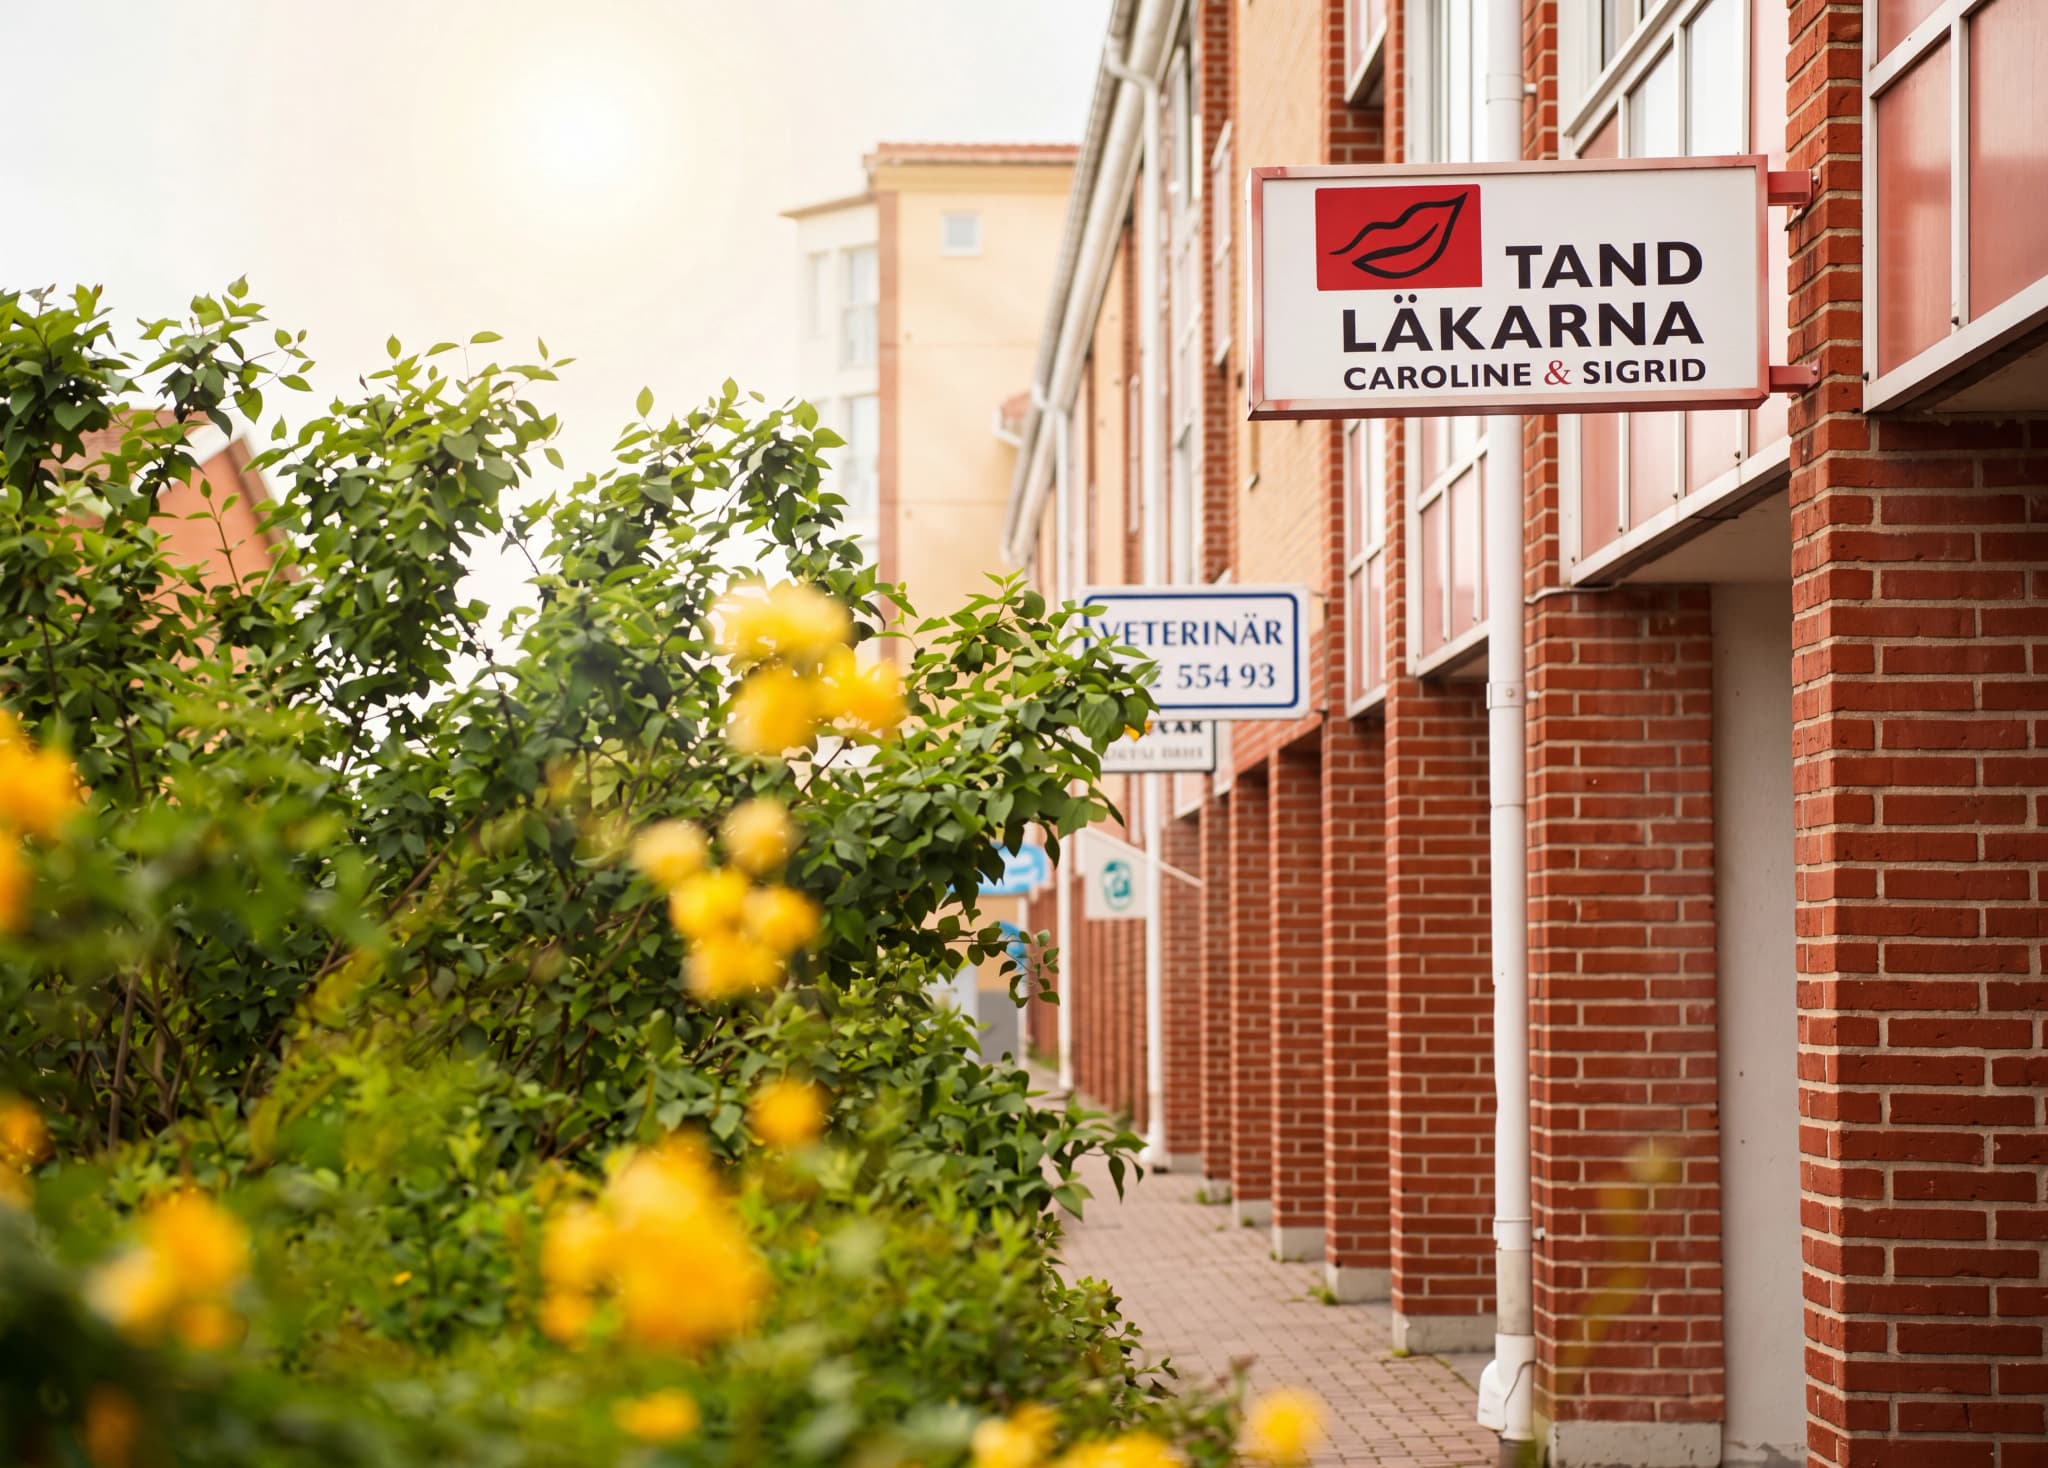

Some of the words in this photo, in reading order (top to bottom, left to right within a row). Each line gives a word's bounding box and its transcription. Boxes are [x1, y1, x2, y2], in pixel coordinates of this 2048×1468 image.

[1505, 240, 1704, 290] TAND
[1342, 294, 1705, 354] LÄKARNA
[1343, 363, 1532, 392] CAROLINE
[1543, 360, 1573, 386] &
[1582, 359, 1707, 386] SIGRID
[1100, 613, 1284, 647] VETERINÄR
[1177, 663, 1233, 690] 554
[1239, 663, 1276, 690] 93
